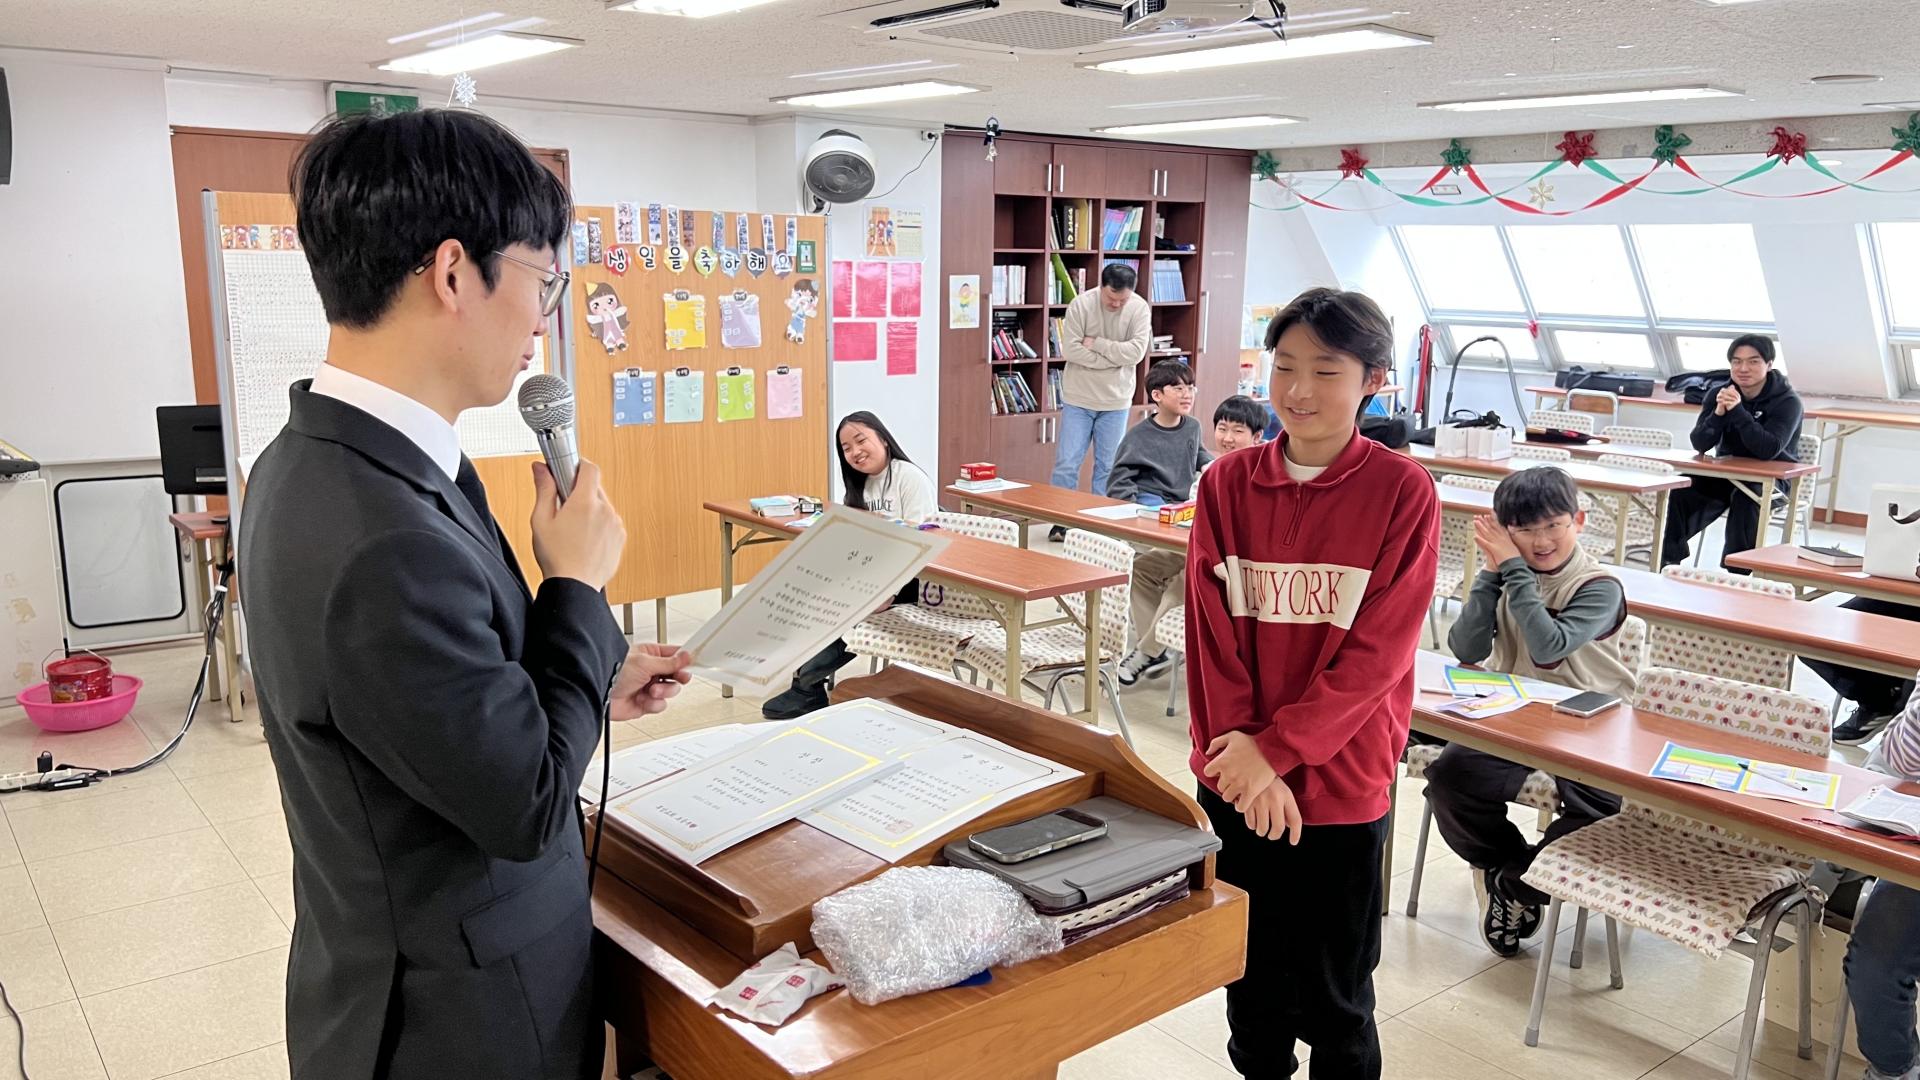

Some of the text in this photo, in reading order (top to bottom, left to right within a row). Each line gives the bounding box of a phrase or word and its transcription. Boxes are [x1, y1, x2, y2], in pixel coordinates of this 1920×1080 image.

[608, 246, 791, 272] 생일을 축하해요
[1269, 570, 1345, 616] YORK
